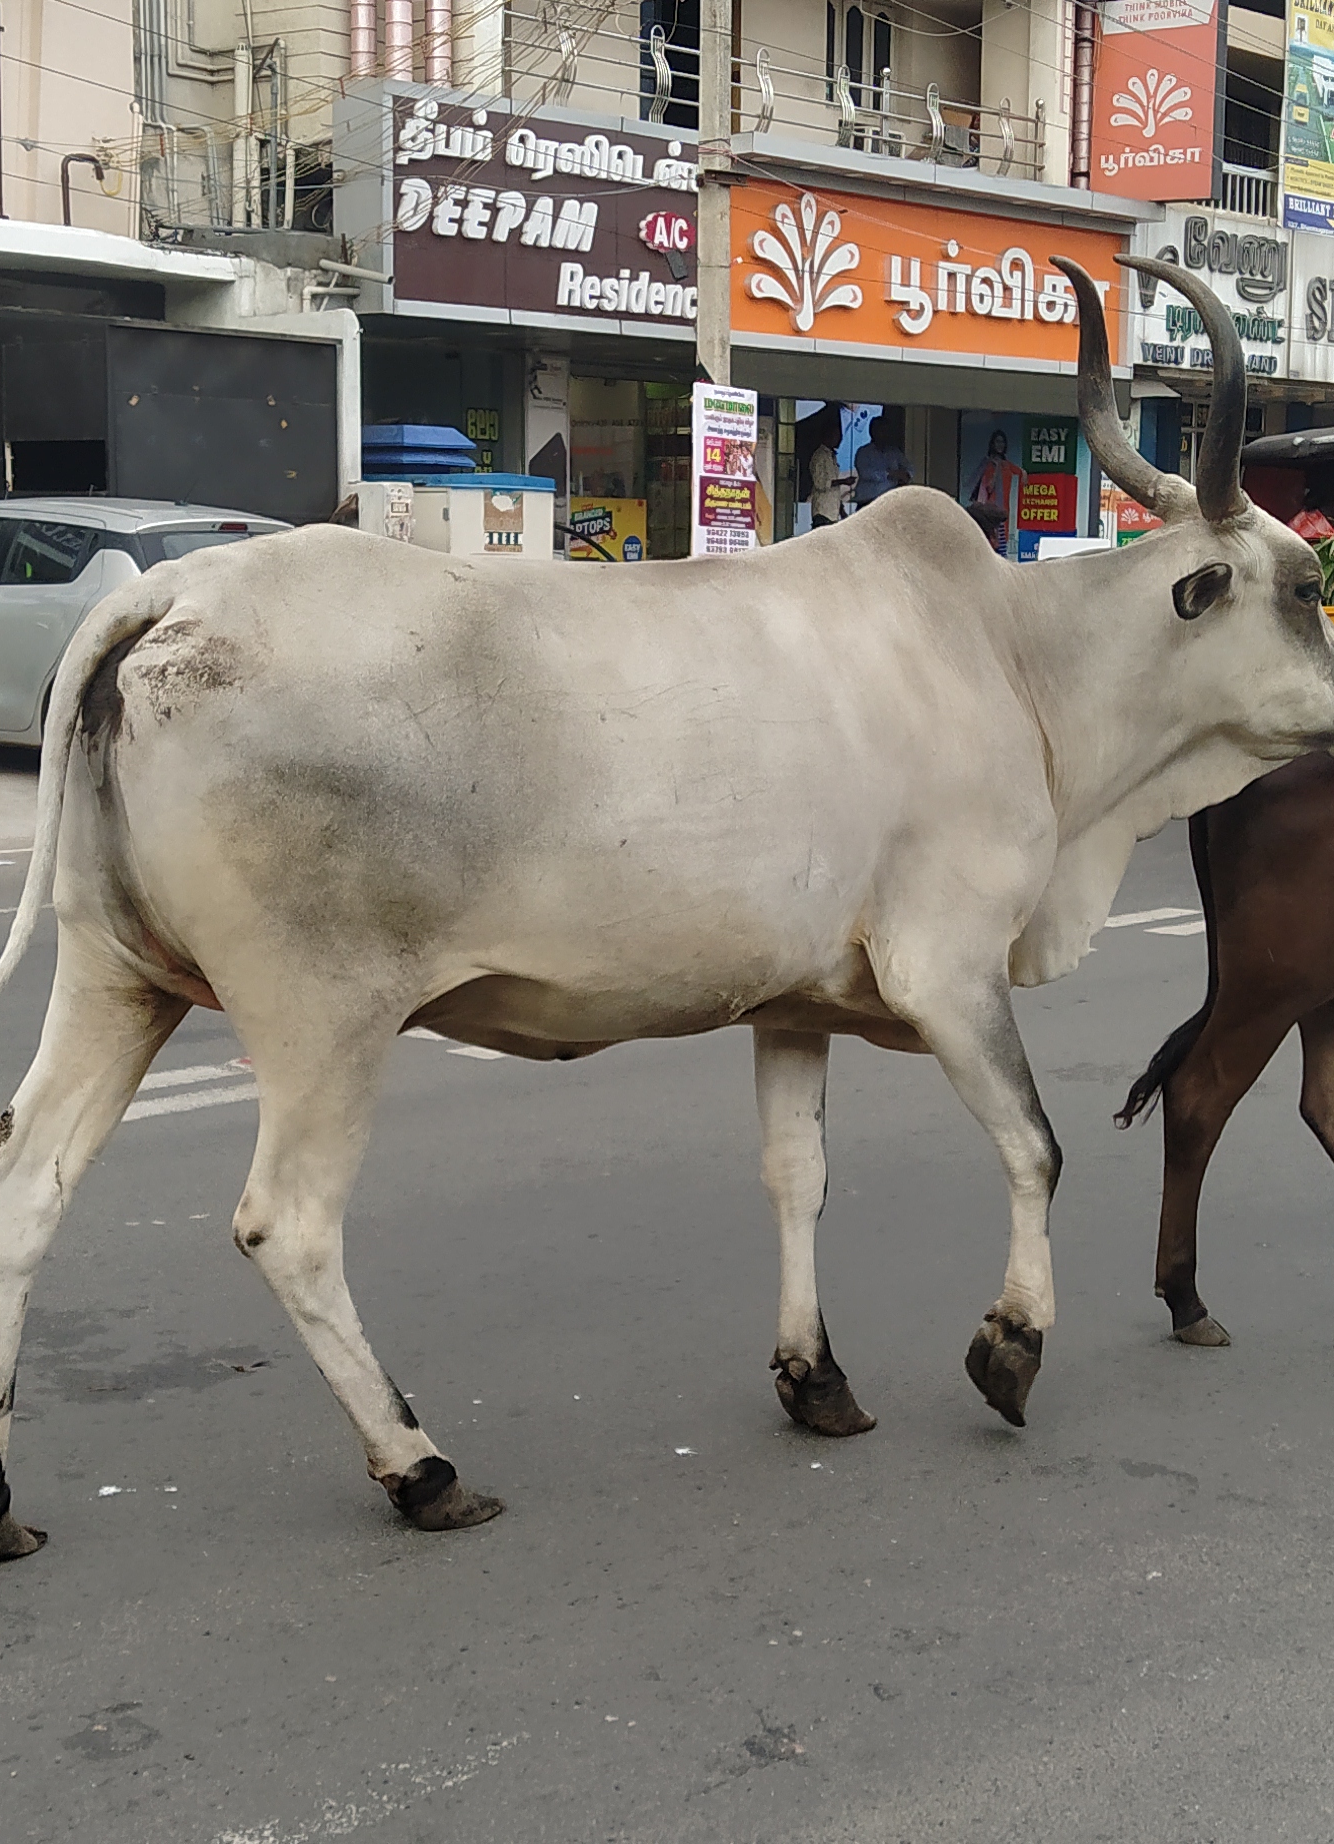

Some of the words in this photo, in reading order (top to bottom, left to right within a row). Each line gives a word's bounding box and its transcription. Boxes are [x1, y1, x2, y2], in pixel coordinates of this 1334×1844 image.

[505, 128, 699, 192] ரெஸிடென்
[1100, 146, 1202, 177] பூர்விகா
[397, 178, 599, 252] DEEPAM
[1288, 197, 1331, 217] BRILLIANT
[653, 217, 689, 250] A/C
[1184, 216, 1289, 303] வேணு
[556, 261, 698, 320] Residenc
[1141, 342, 1185, 366] VENU
[1030, 427, 1069, 442] EASY
[706, 446, 722, 463] 14
[1031, 445, 1066, 463] EMI
[1023, 484, 1057, 497] MEGA
[1021, 508, 1059, 522] OFFER
